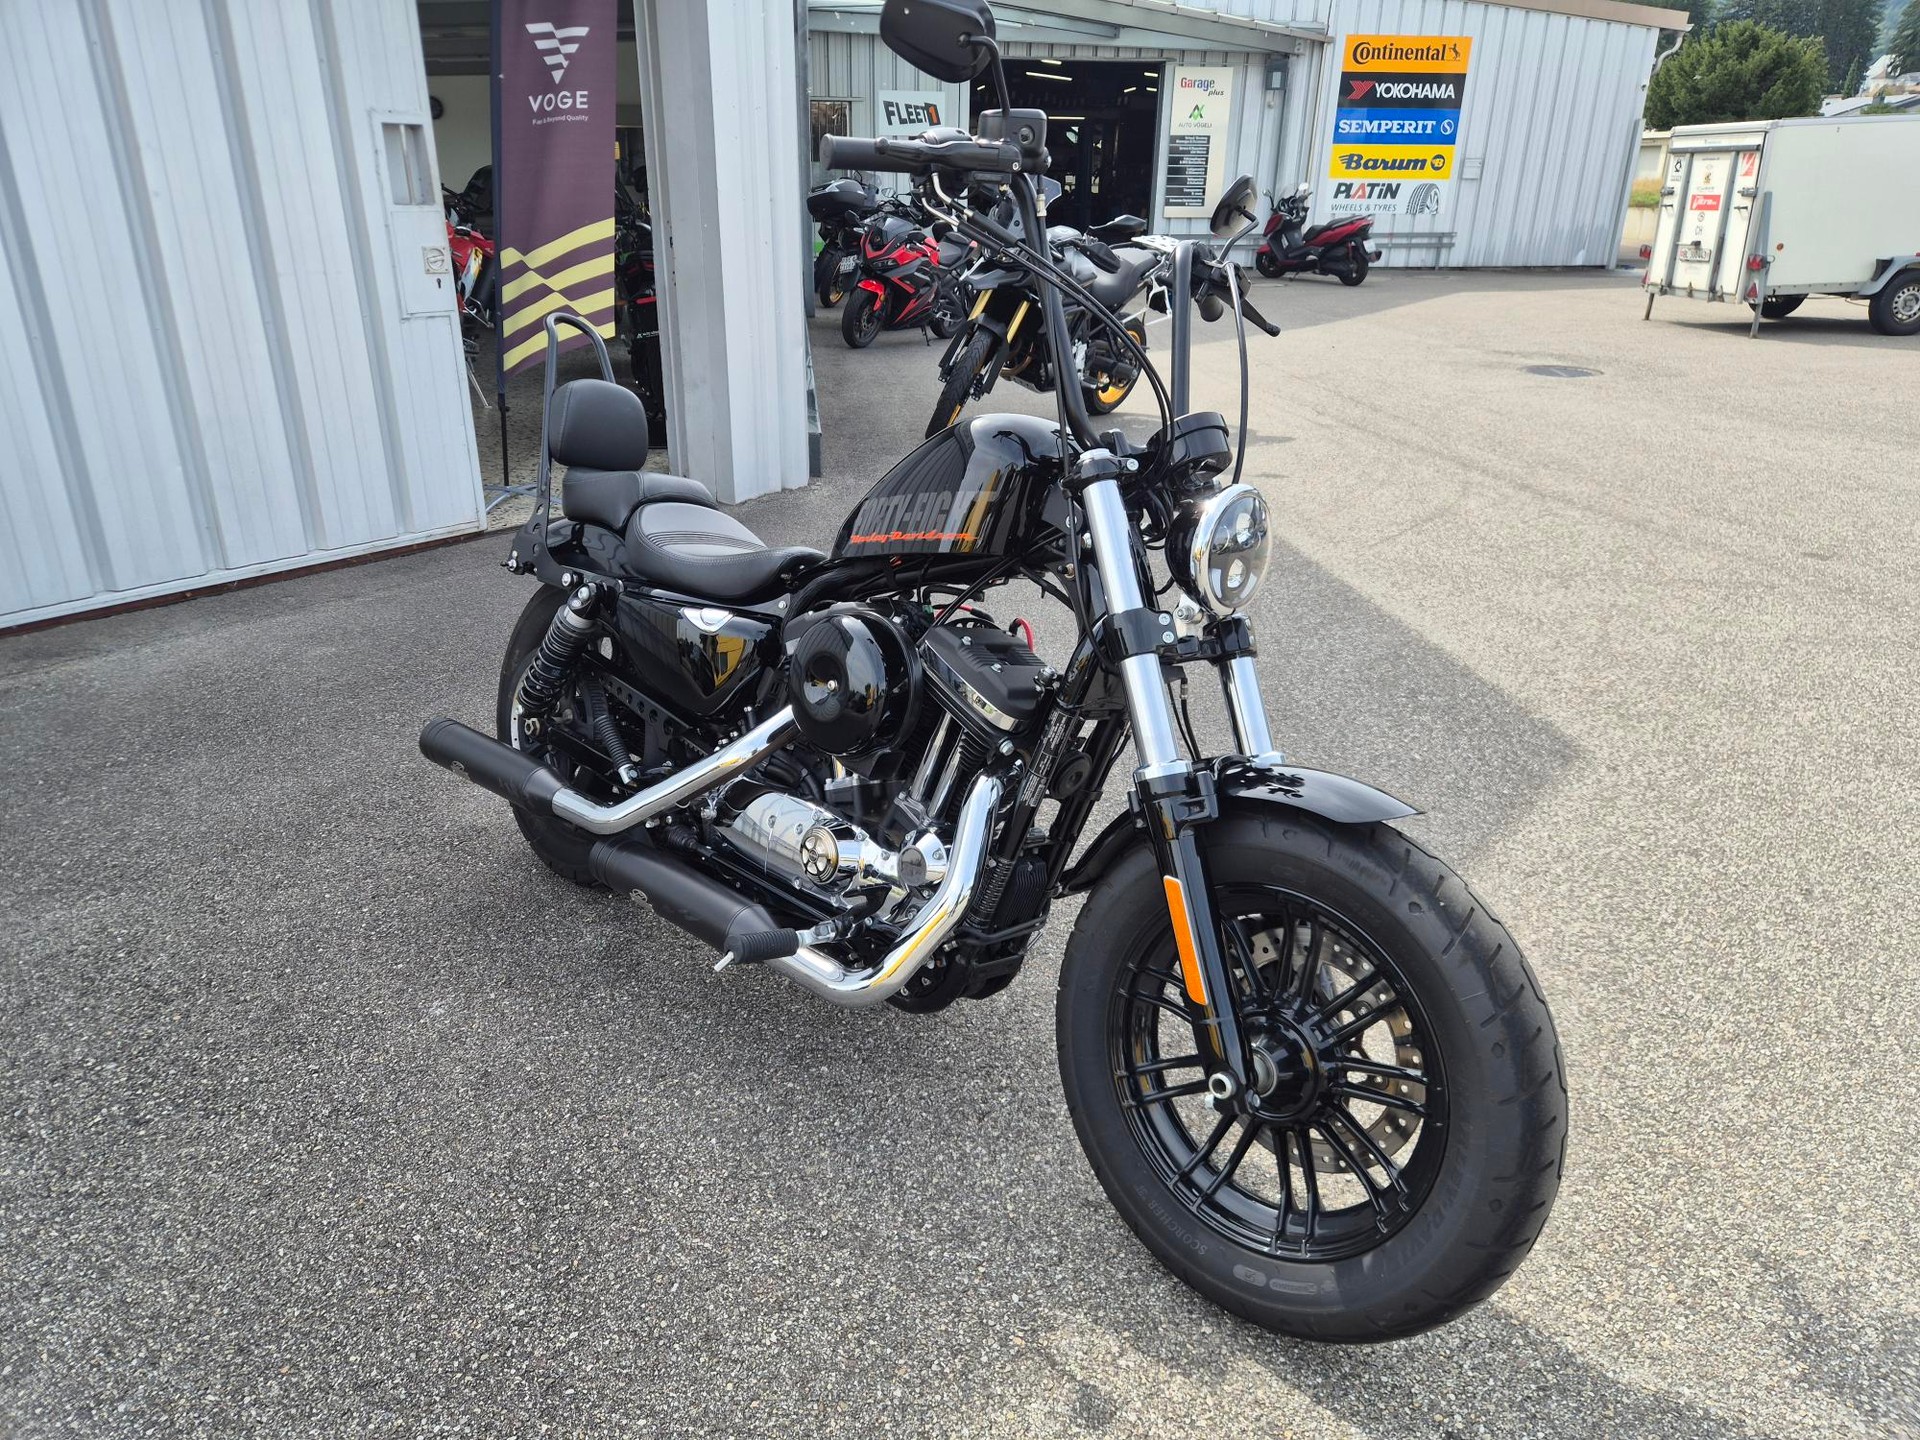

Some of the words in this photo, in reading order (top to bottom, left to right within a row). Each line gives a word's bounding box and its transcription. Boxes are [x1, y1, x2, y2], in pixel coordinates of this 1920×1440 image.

[1352, 41, 1447, 65] Continental
[1180, 77, 1215, 91] Garage
[1374, 82, 1456, 99] YOKOHAMA
[1207, 89, 1225, 97] plus
[528, 90, 589, 113] VOGE
[566, 114, 589, 122] Quality
[1338, 119, 1436, 134] SEMPERIT
[1339, 153, 1428, 171] Barum
[1330, 203, 1363, 212] WHEELS
[1364, 203, 1370, 212] &
[1372, 203, 1398, 212] TYRES
[1147, 1200, 1209, 1256] SCORCHER
